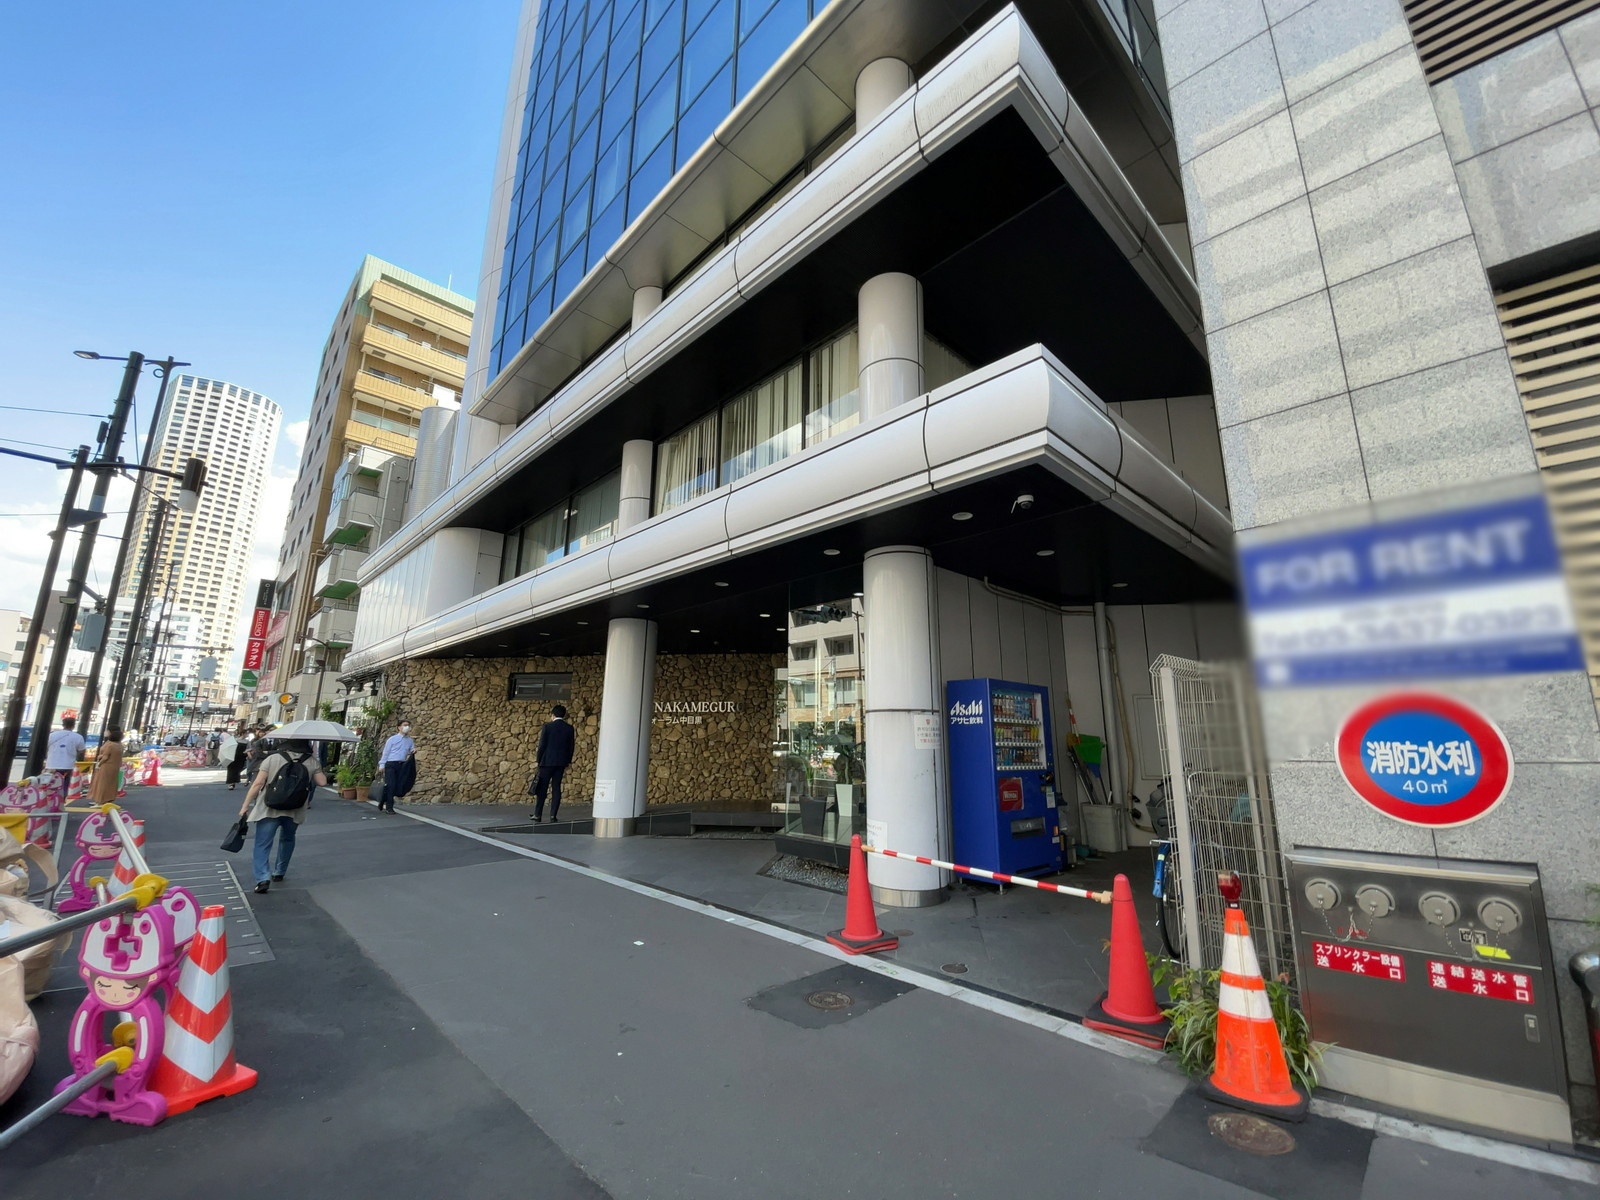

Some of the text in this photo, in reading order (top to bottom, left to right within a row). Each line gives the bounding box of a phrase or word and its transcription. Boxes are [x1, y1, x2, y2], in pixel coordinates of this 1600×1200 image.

[1255, 518, 1531, 594] FOR RENT
[248, 641, 260, 667] カラオケ
[950, 699, 983, 716] Asahi
[950, 716, 984, 725] アサヒ飲料
[1366, 740, 1476, 776] 消防水利
[1316, 943, 1401, 968] スプリンクラー設備
[1431, 962, 1528, 987] 連結送水管
